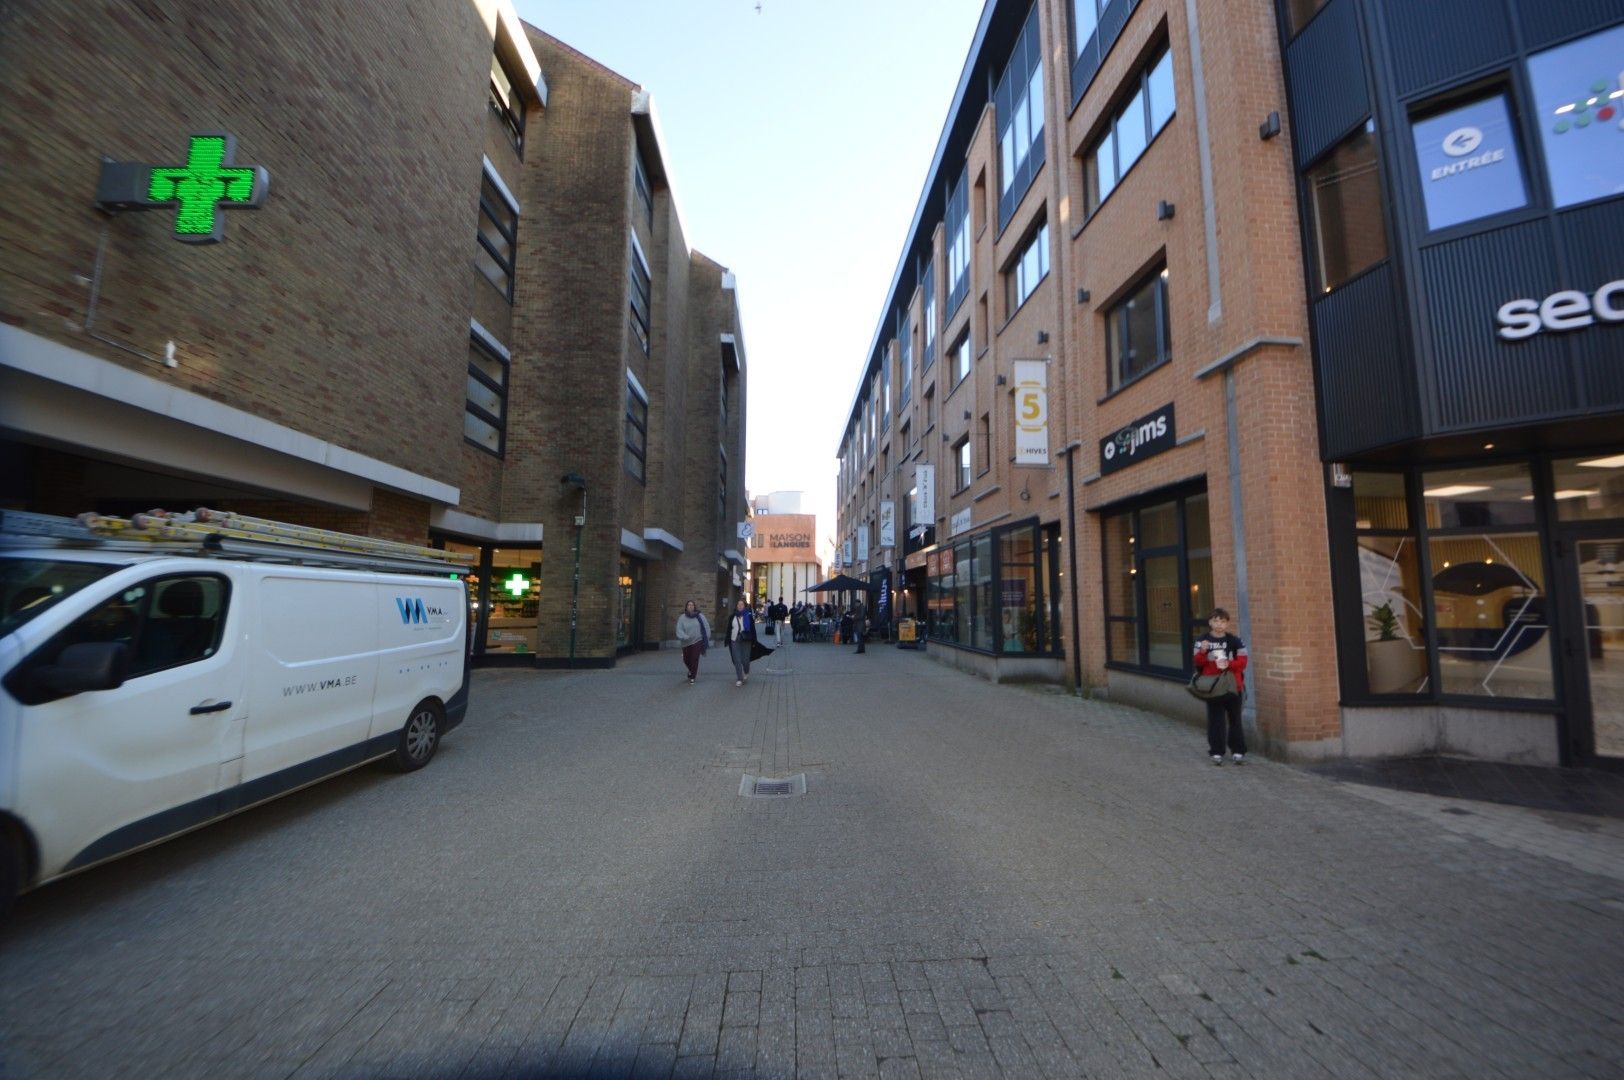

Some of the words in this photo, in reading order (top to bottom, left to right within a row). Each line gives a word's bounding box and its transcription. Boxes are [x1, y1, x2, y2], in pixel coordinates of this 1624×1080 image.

[1430, 148, 1505, 181] ENTRÉE
[1022, 393, 1041, 420] 5
[1130, 415, 1167, 456] jims
[1026, 447, 1047, 455] HIVES
[769, 533, 811, 541] MAISON
[427, 606, 443, 616] VMA
[282, 675, 358, 697] WWW.VMA.BE
